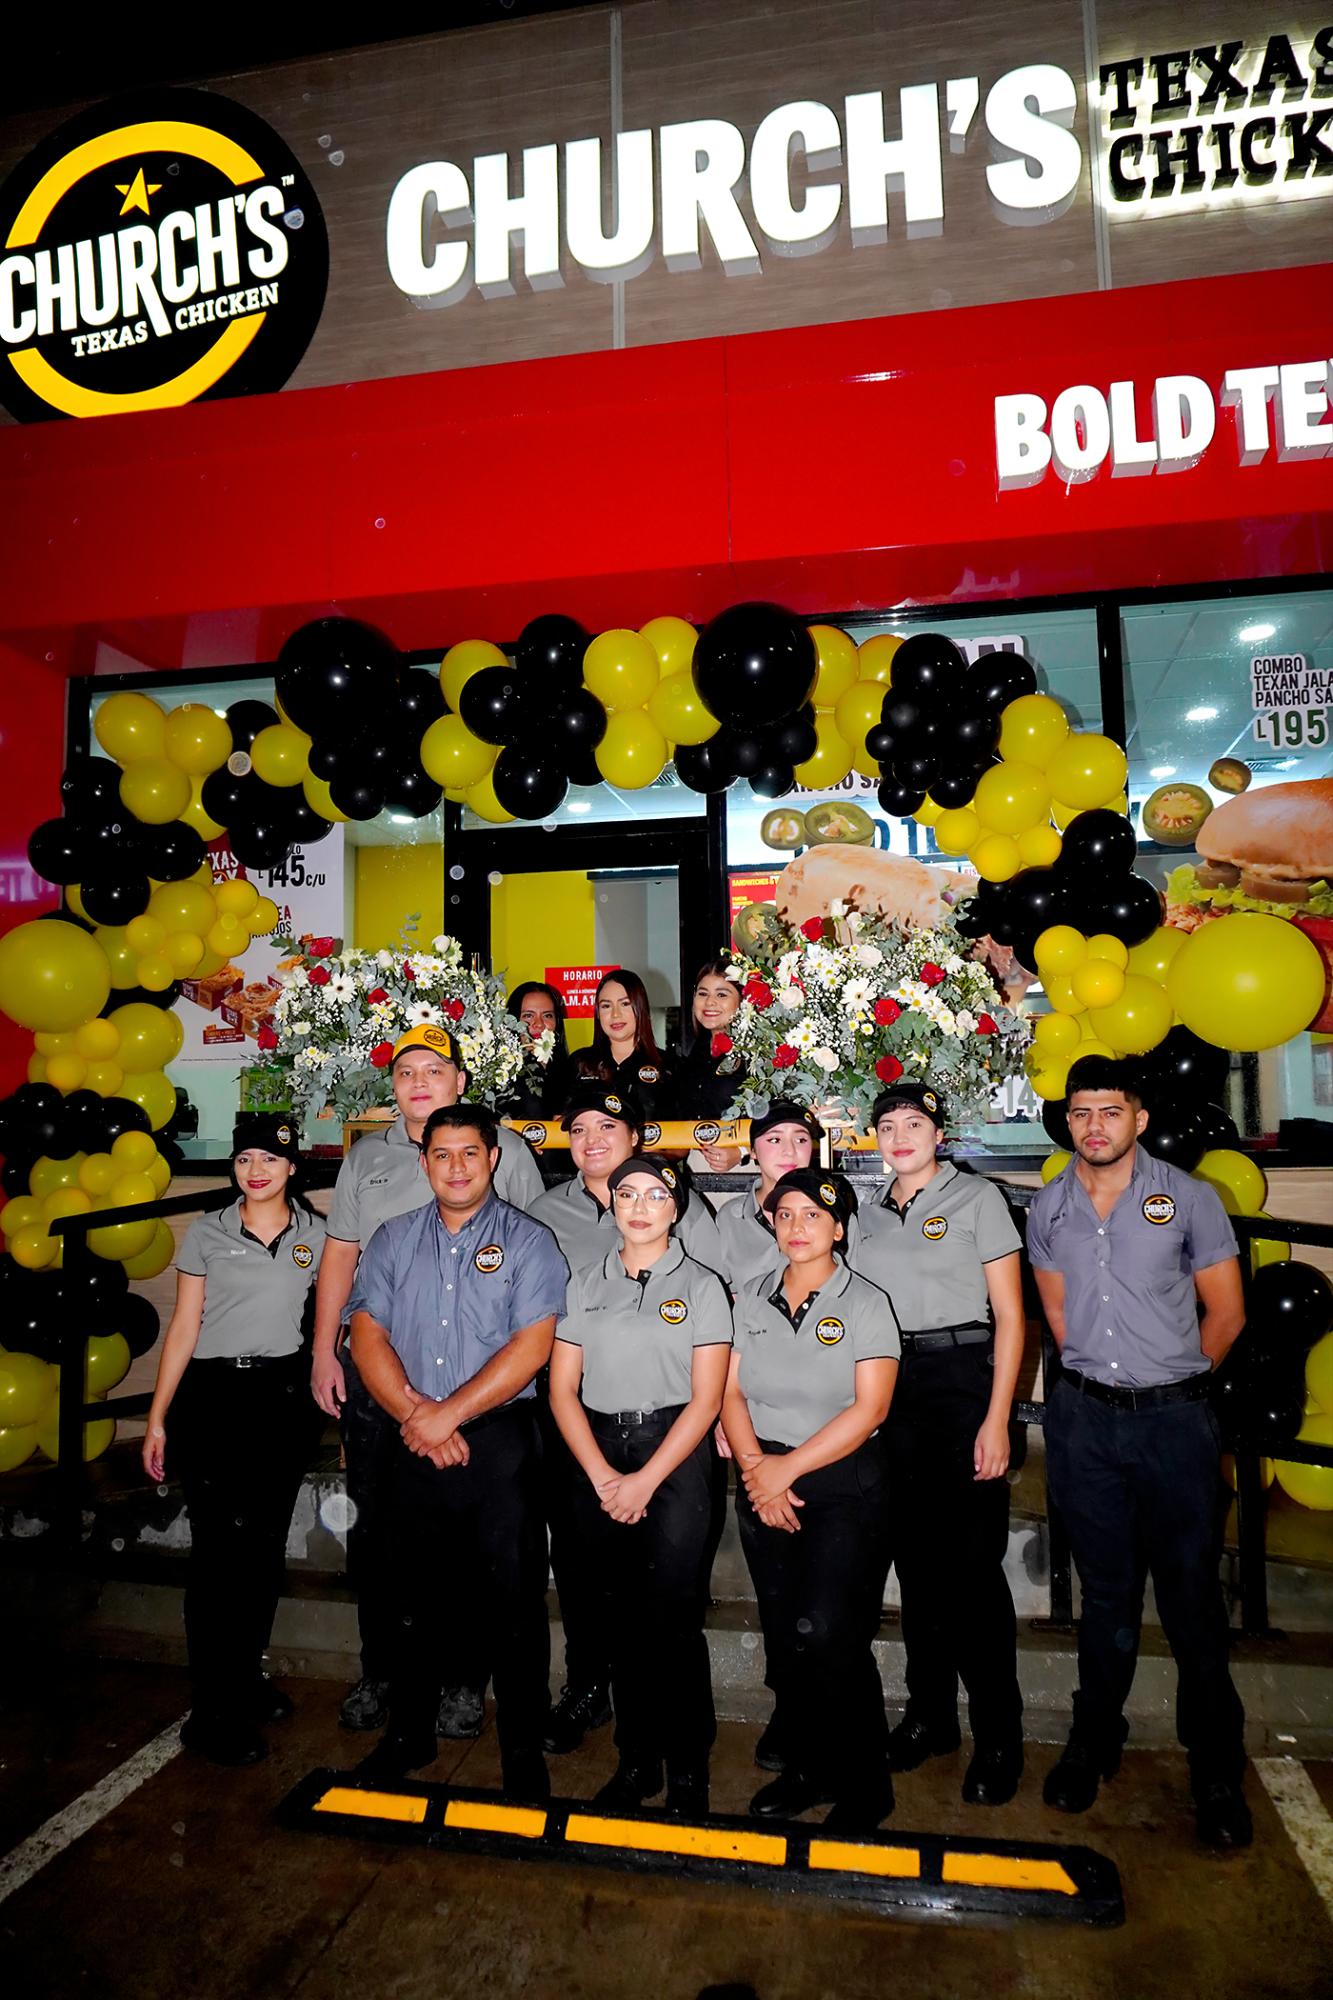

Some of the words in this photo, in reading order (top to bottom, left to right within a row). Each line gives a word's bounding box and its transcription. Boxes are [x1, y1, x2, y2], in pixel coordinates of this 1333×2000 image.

[386, 64, 1081, 297] CHURCH'S
[1107, 109, 1333, 194] CHICK
[0, 185, 288, 343] CHURCH'S
[71, 321, 148, 357] TEXAS
[175, 282, 279, 330] CHICKEN
[995, 375, 1215, 482] BOLD
[1222, 360, 1333, 454] TE
[1254, 657, 1303, 675] COMBO
[1254, 673, 1299, 691] TEXAN
[1255, 689, 1310, 707] PANCHO
[563, 970, 602, 981] HORARIO
